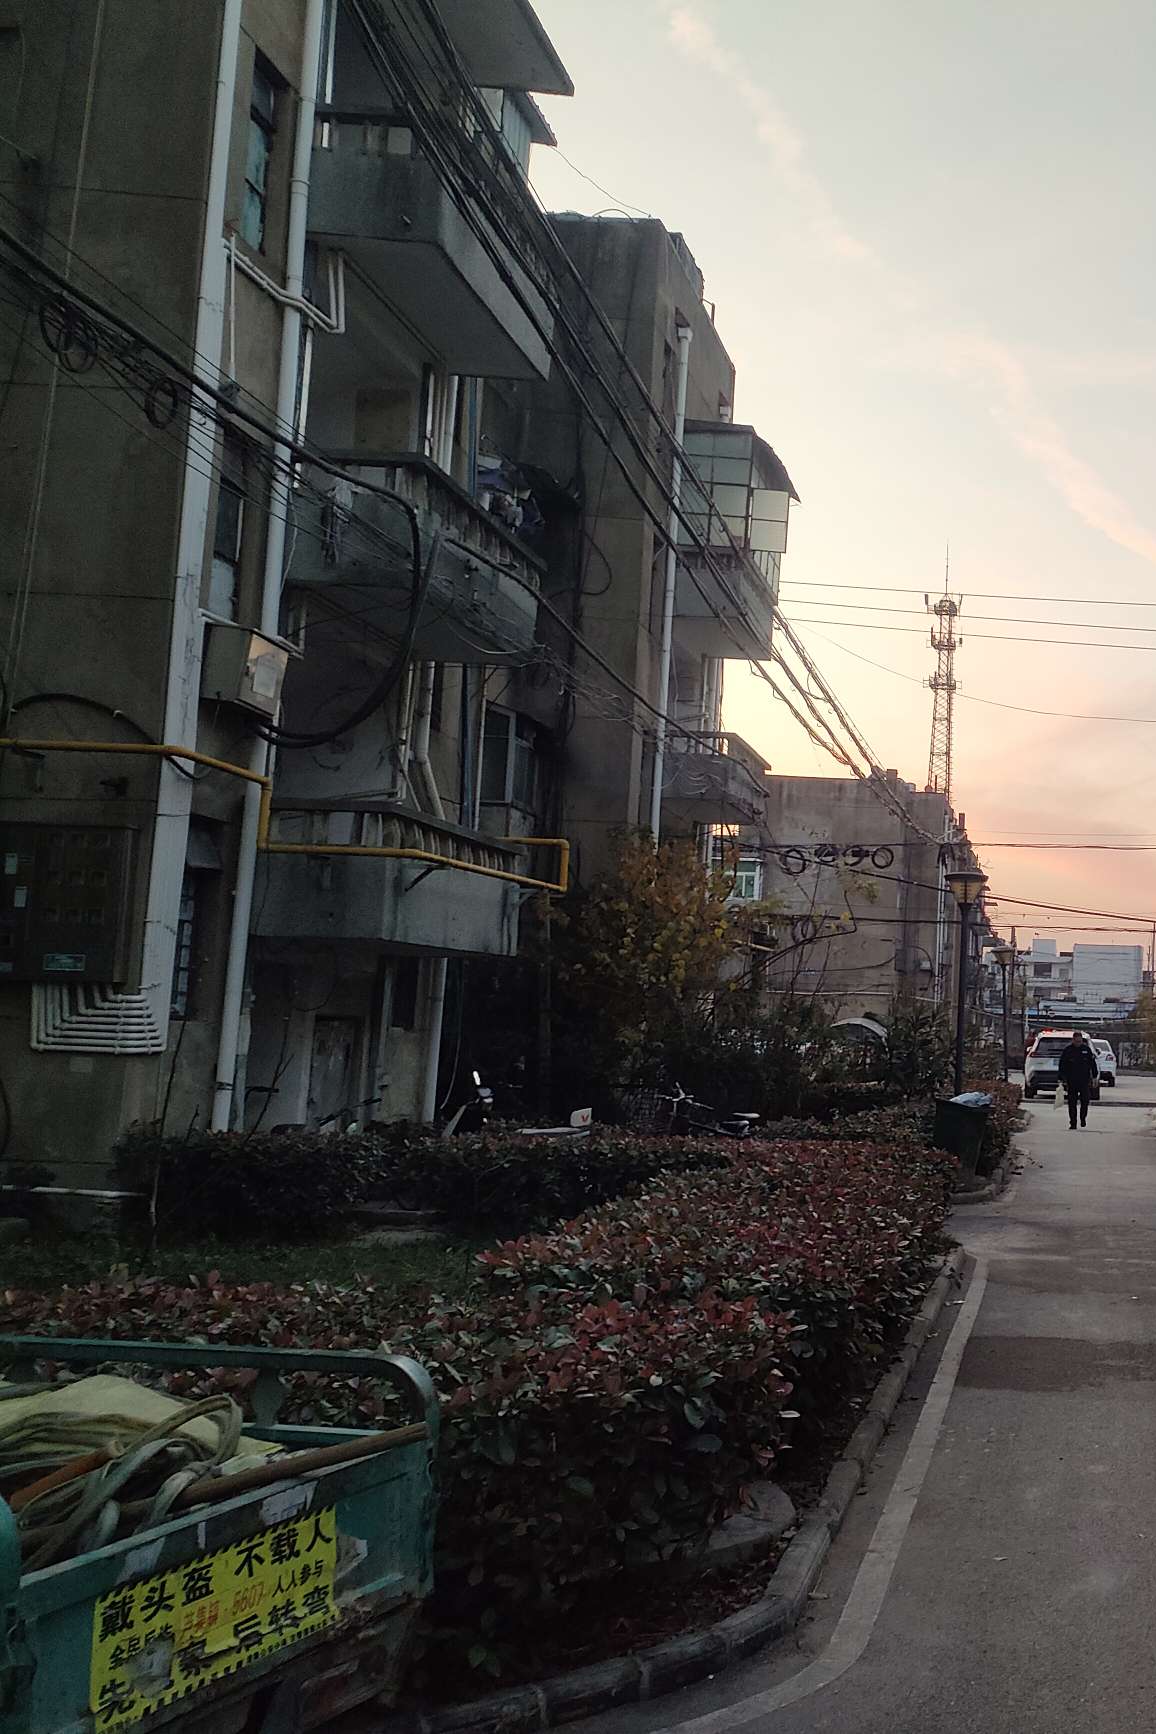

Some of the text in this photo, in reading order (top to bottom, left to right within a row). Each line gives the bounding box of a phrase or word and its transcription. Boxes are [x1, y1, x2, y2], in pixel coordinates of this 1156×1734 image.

[99, 1518, 333, 1643] 戴头盔 不载人
[272, 1559, 324, 1598] 人人参与
[232, 1584, 331, 1652] 后转弯
